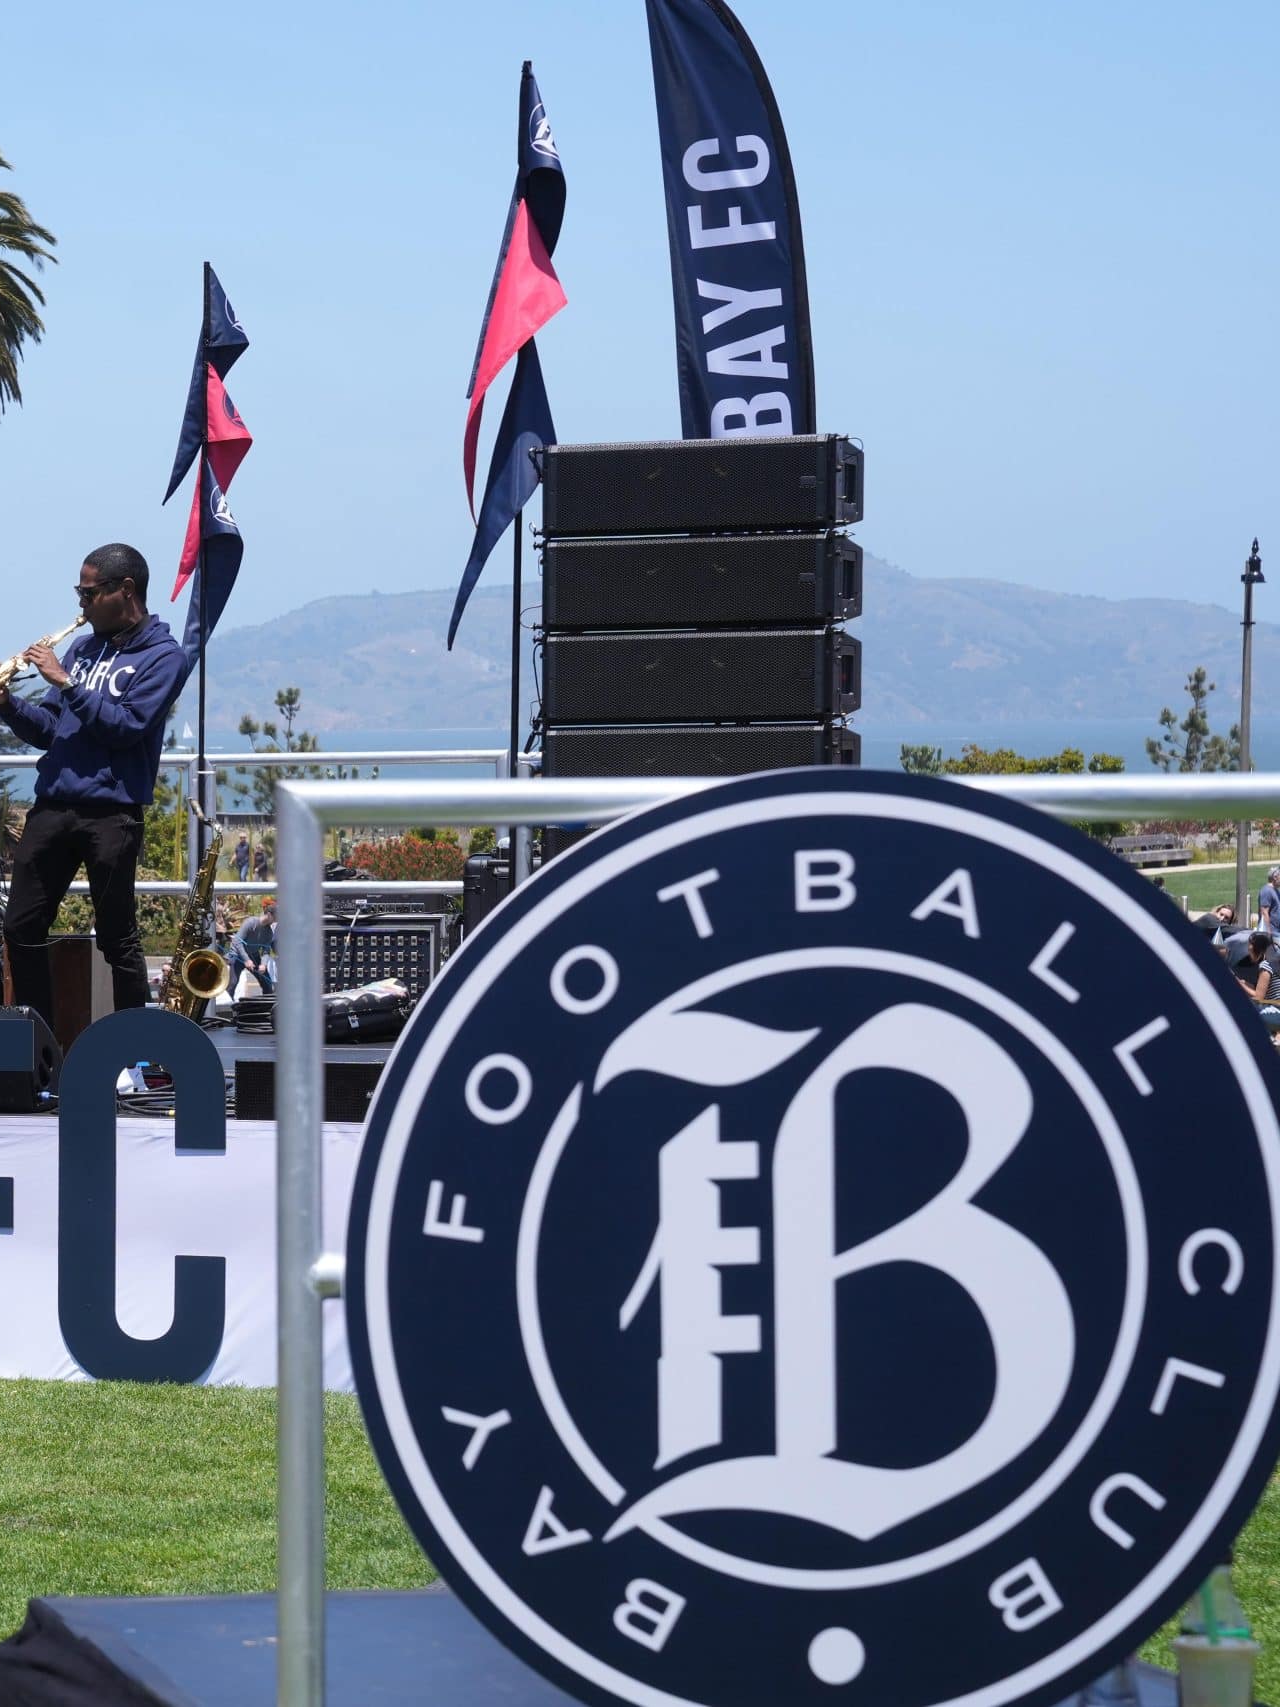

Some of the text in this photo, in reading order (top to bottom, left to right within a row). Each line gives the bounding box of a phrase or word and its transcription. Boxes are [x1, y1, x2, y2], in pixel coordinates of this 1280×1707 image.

[682, 134, 793, 438] BAY FC
[423, 849, 1245, 1653] BAY FOOTBALL CLUB
